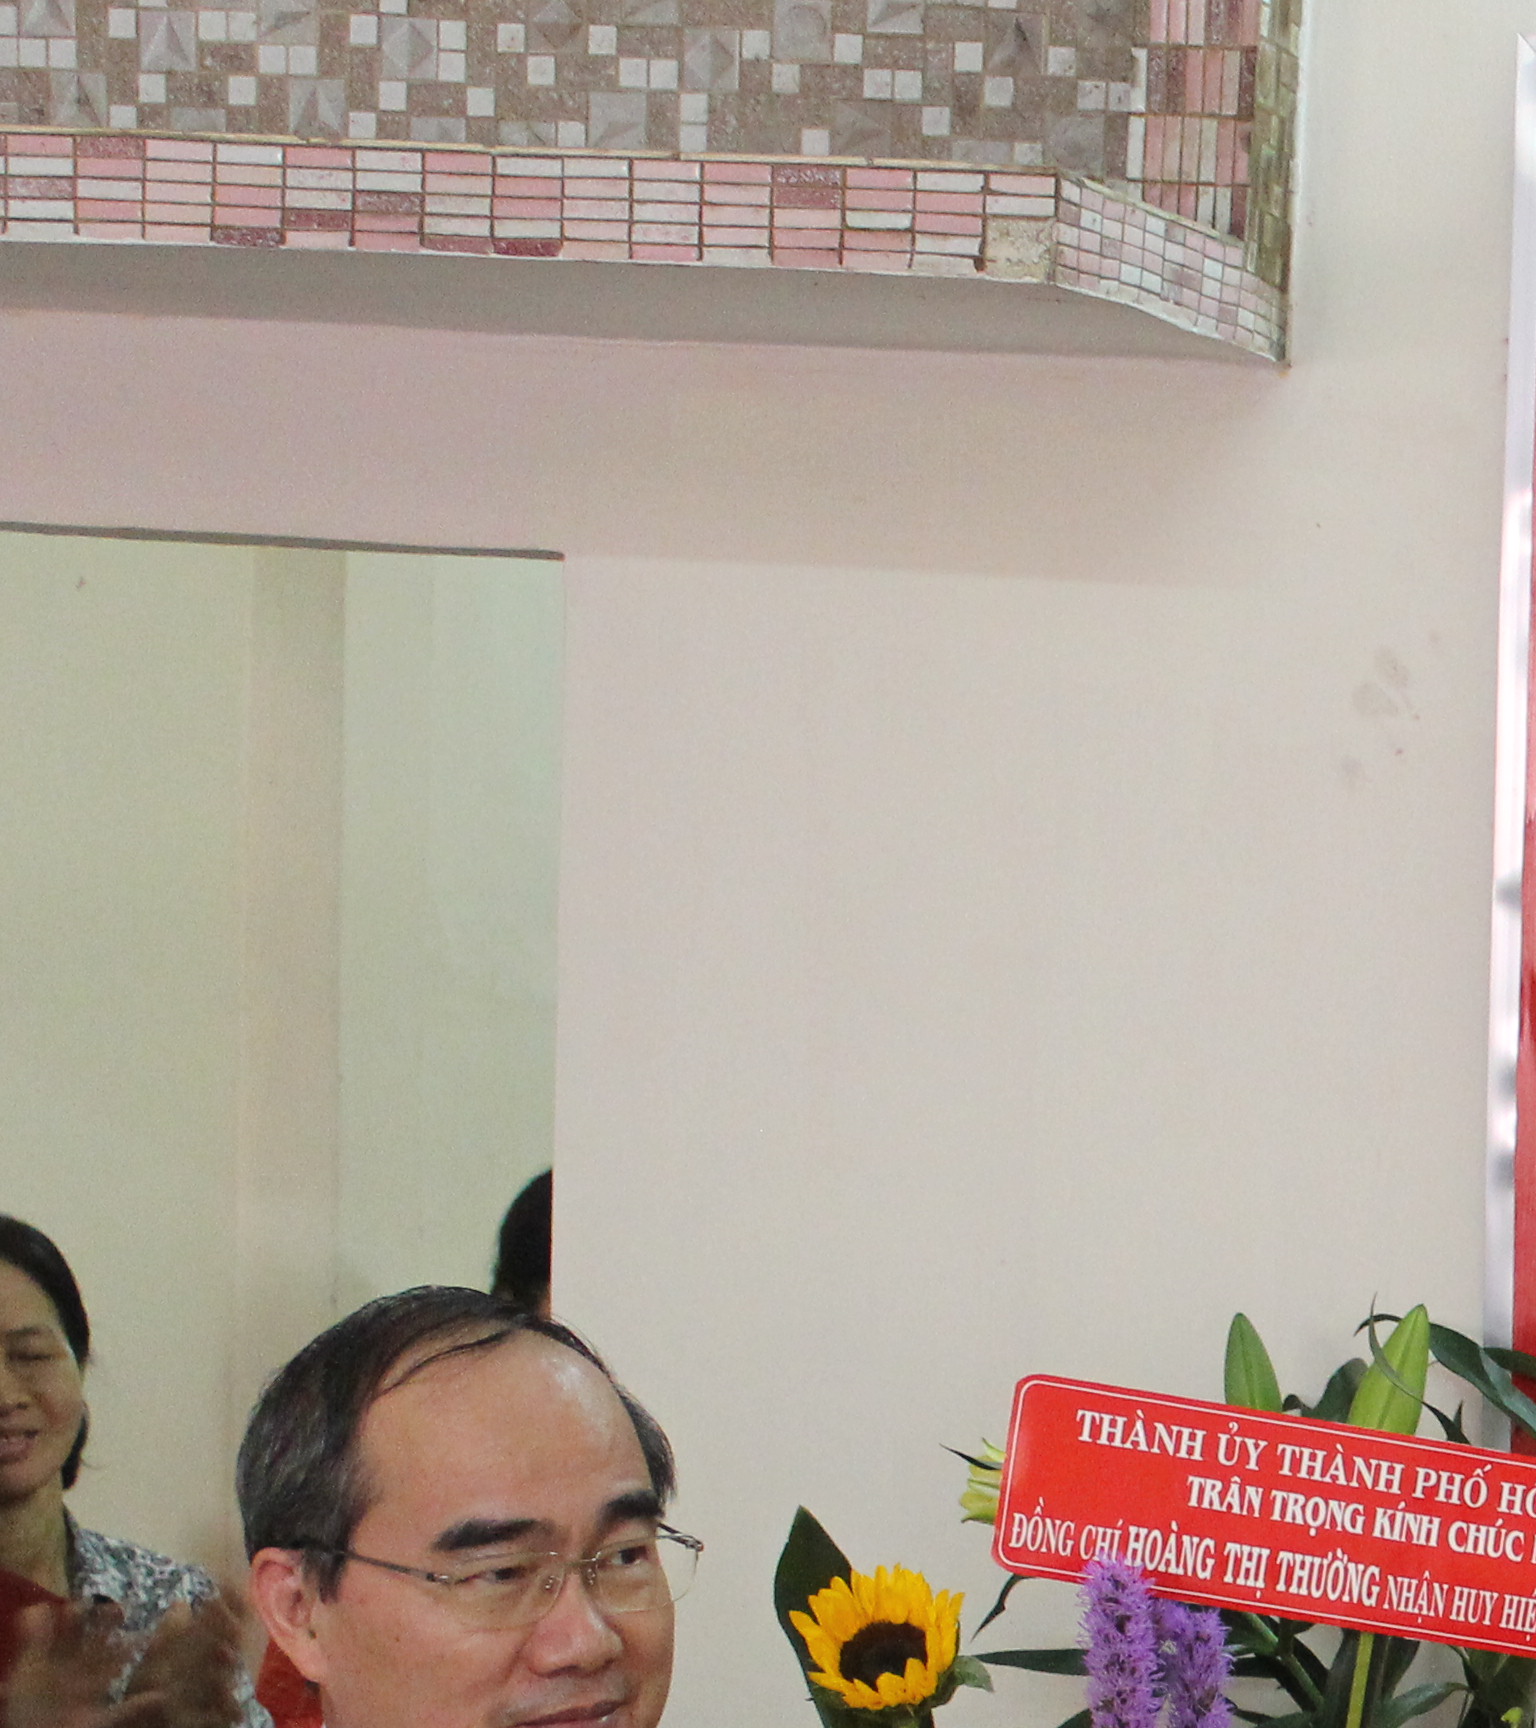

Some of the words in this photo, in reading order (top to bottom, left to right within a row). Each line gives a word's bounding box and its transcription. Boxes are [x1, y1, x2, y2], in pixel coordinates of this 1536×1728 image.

[1076, 1409, 1207, 1461] THÀNH
[1217, 1421, 1268, 1472] ỦY
[1277, 1441, 1405, 1496] THÀNH
[1412, 1464, 1492, 1509] PHỐ
[1009, 1497, 1075, 1557] ĐỒNG
[1079, 1519, 1124, 1562] CHÍ
[1127, 1520, 1216, 1580] HOÀNG
[1224, 1542, 1270, 1598] THỊ
[1276, 1547, 1381, 1608] THƯỜNG
[1383, 1570, 1448, 1624] NHẬN
[1450, 1586, 1499, 1625] HUY
[1187, 1475, 1264, 1517] TRÂN
[1270, 1489, 1366, 1538] TRỌNG
[1373, 1502, 1440, 1548] KÍNH
[1447, 1519, 1525, 1562] CHÚC
